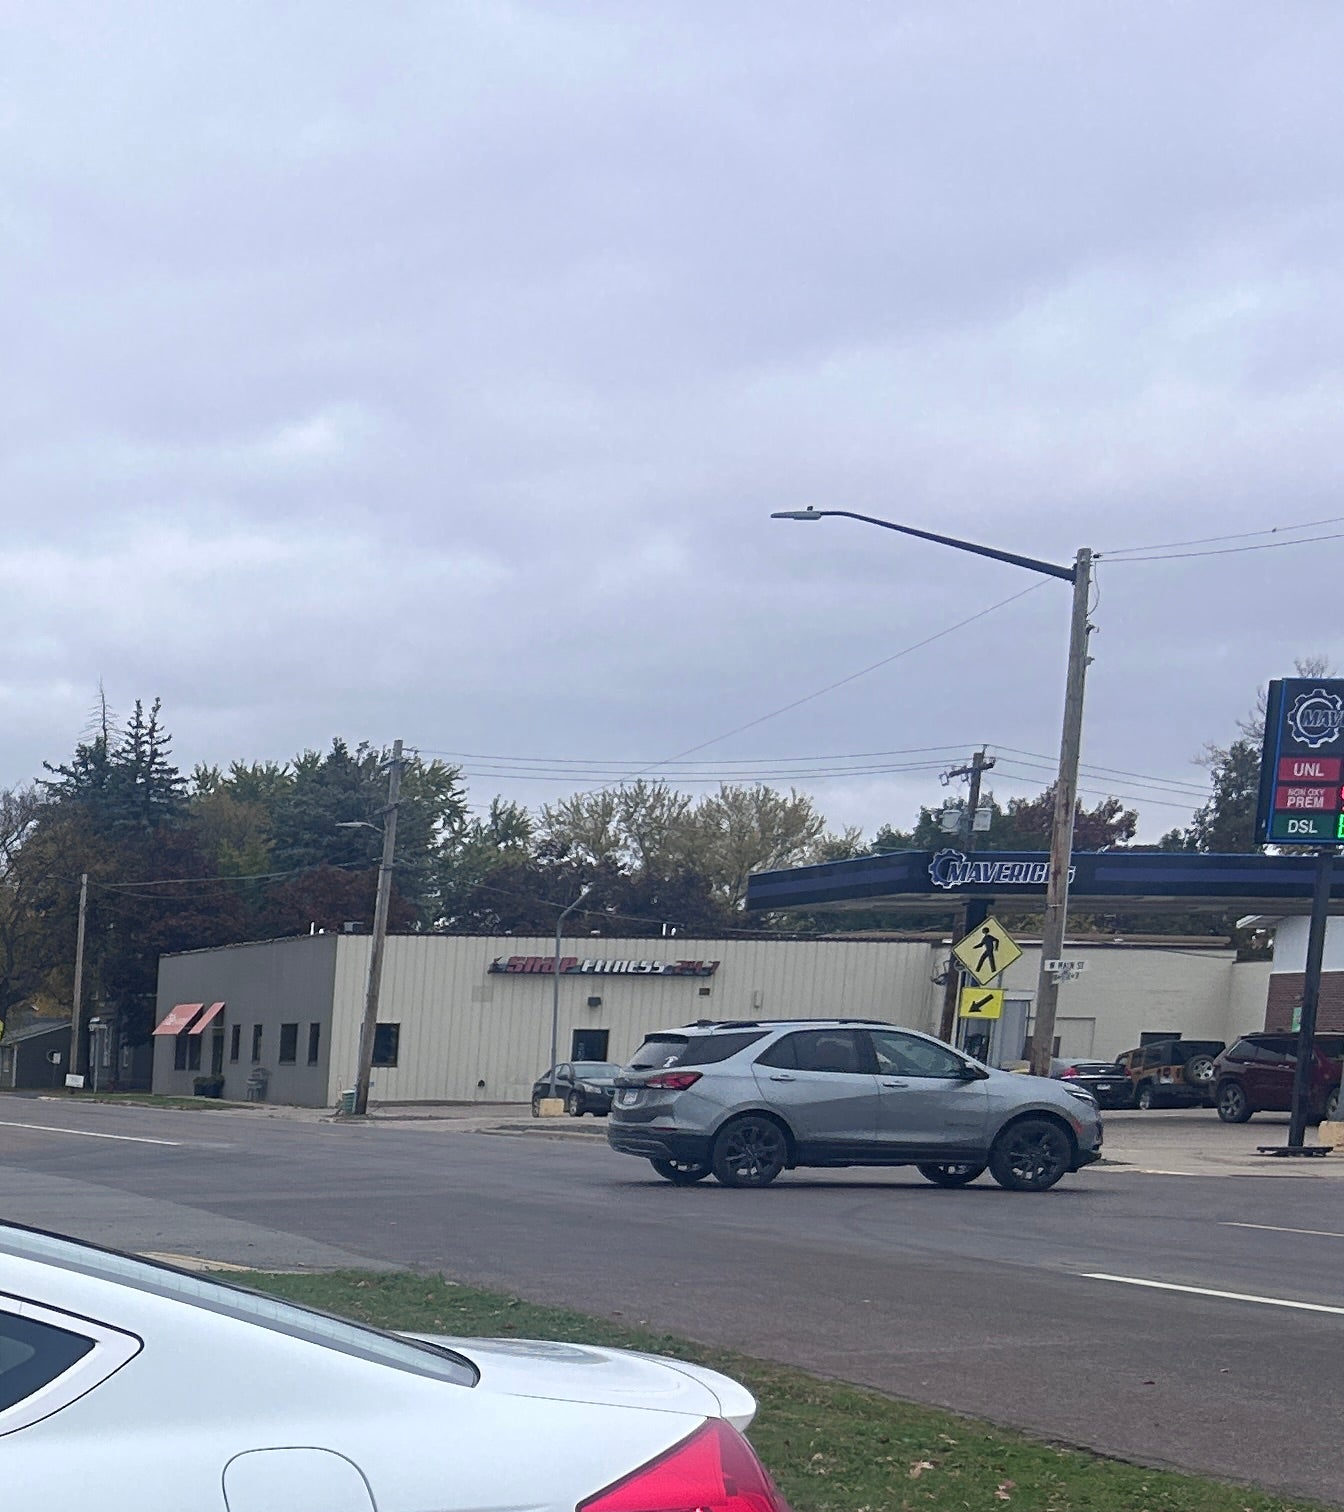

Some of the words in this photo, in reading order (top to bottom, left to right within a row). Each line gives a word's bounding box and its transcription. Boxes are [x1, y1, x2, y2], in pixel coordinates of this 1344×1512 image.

[1293, 762, 1325, 777] UNL
[1286, 796, 1325, 809] PREM
[1287, 819, 1319, 834] DSL
